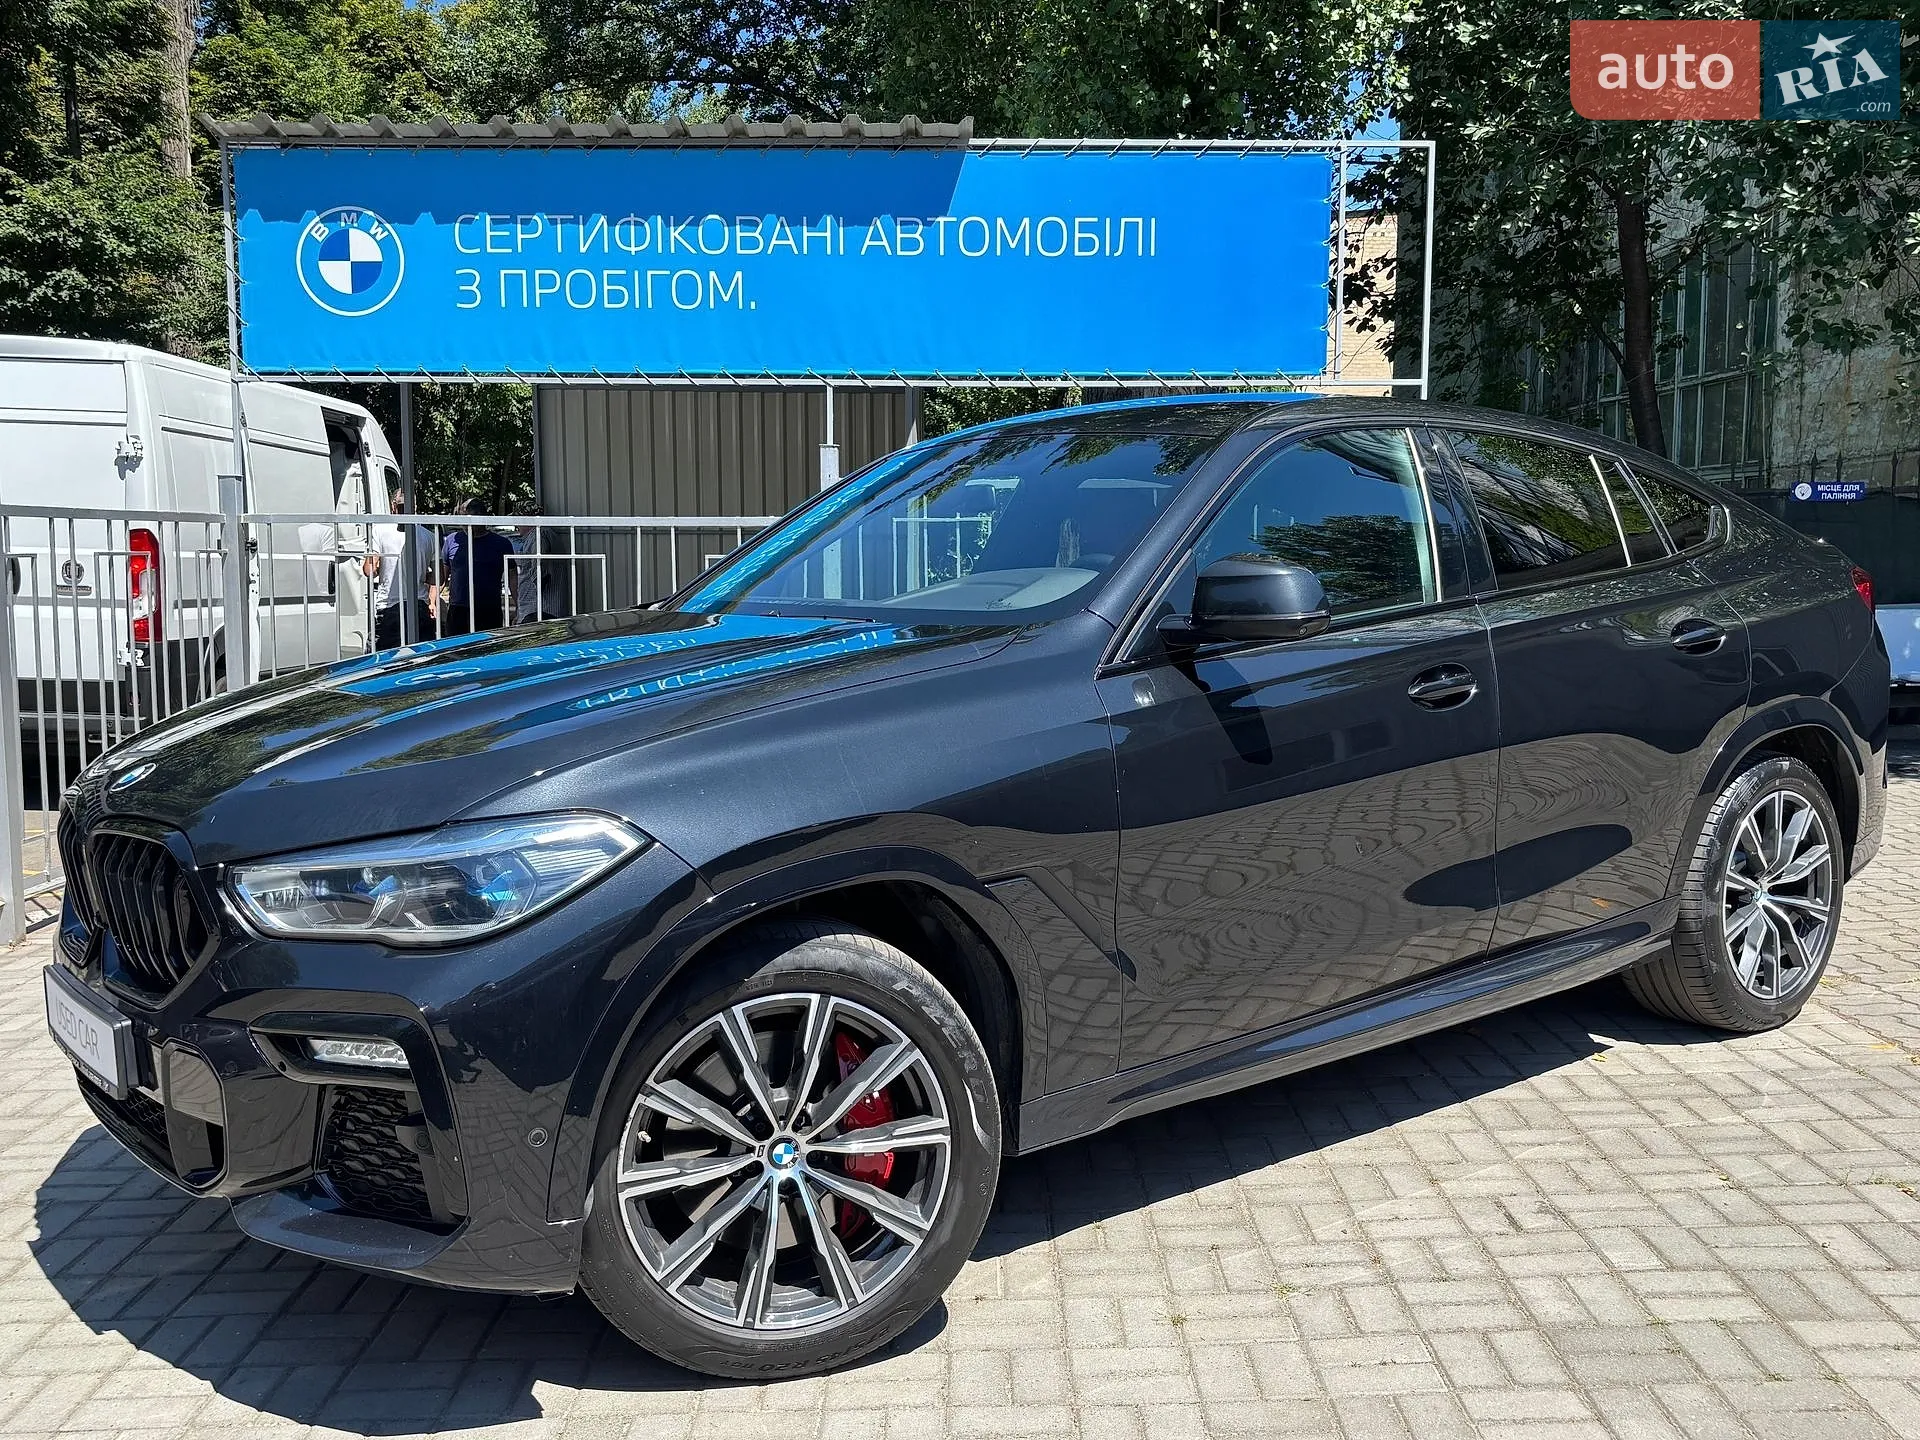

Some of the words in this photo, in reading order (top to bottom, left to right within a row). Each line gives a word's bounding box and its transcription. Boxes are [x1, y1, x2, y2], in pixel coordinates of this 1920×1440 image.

[309, 212, 390, 243] BMW
[453, 212, 845, 256] СЕРТИФІКОВАНІ
[860, 215, 1157, 257] АВТОМОБІЛІ
[455, 268, 482, 309] З
[499, 268, 757, 310] ПРОБІГОМ.
[1817, 484, 1842, 492] МІСЦЕ
[1843, 484, 1860, 492] ДЛЯ
[1821, 492, 1856, 500] ПАЛІННЯ
[56, 994, 78, 1040] USED
[78, 1019, 100, 1060] CAR
